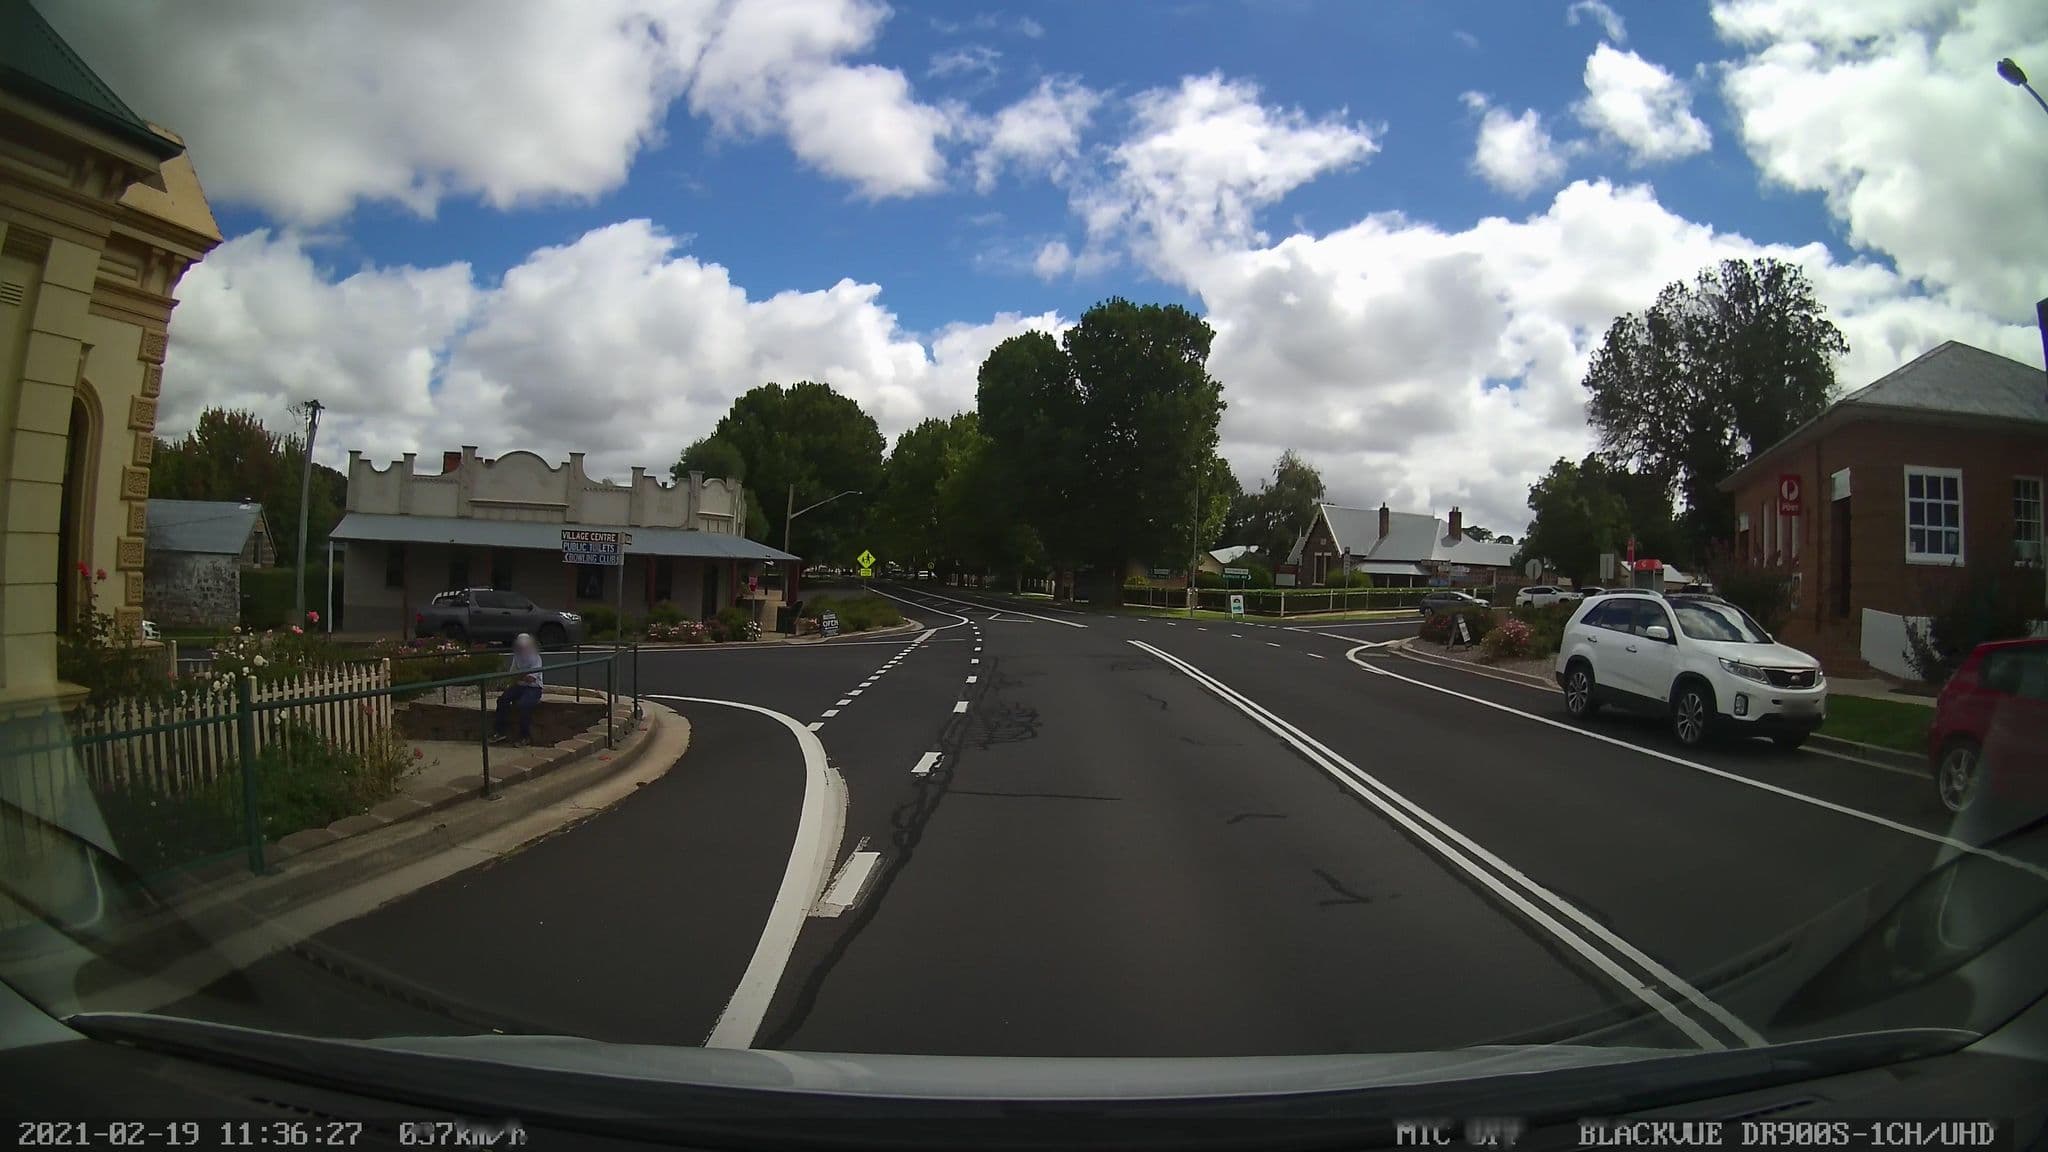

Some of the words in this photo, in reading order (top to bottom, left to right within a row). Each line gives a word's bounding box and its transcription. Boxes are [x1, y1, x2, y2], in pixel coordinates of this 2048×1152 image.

[562, 531, 589, 540] VILLAGE
[590, 532, 616, 542] CENTRE
[563, 541, 587, 552] PUBLIC
